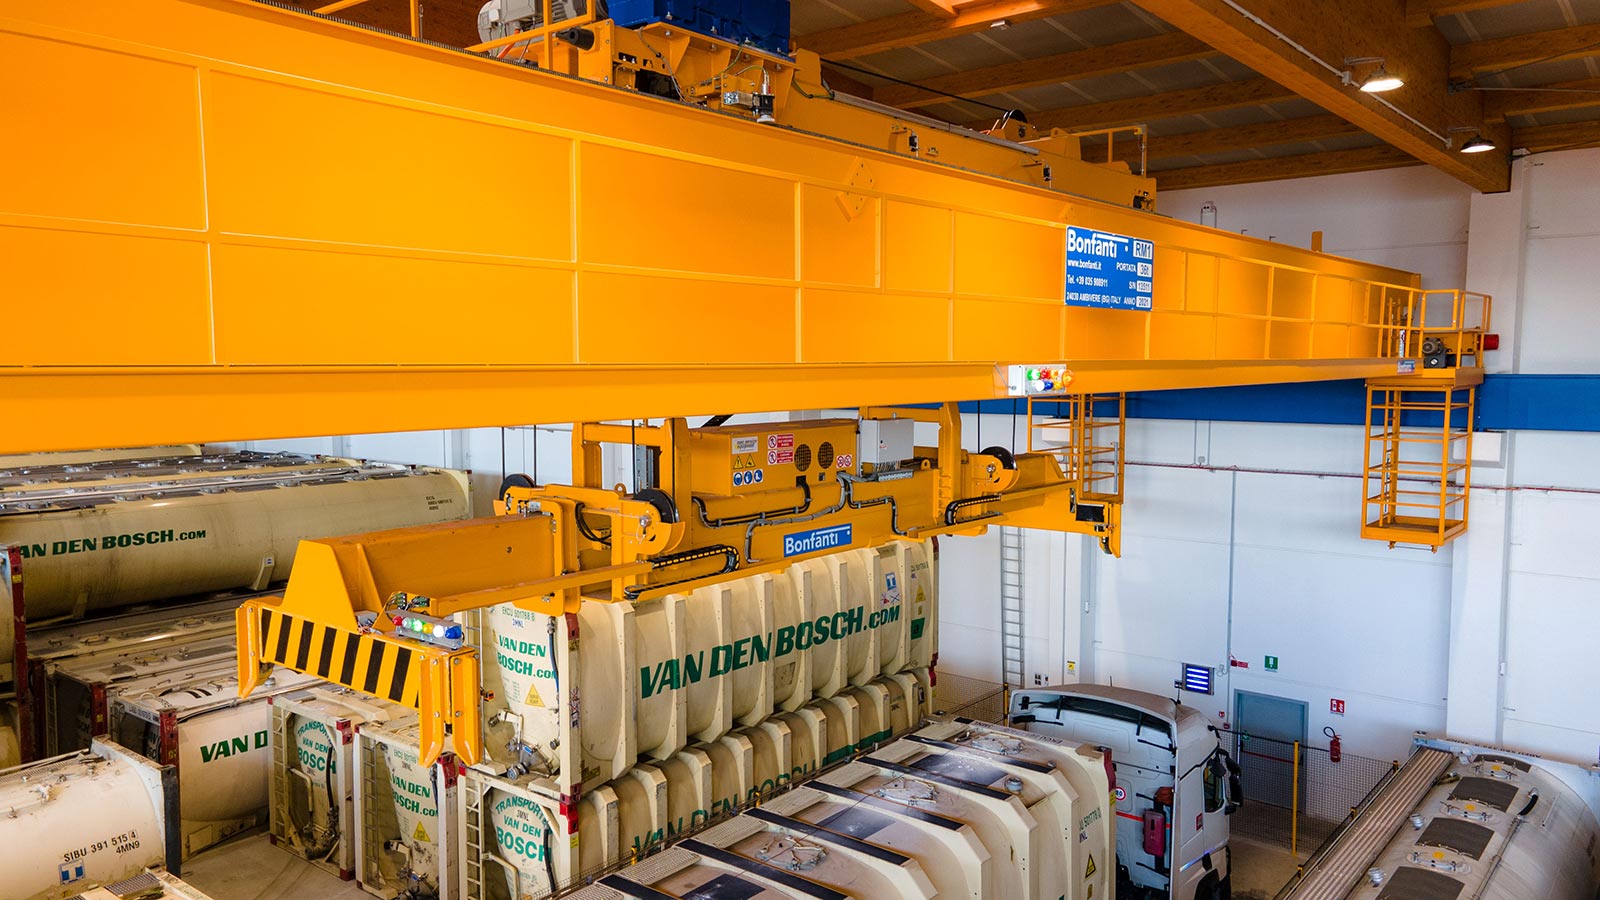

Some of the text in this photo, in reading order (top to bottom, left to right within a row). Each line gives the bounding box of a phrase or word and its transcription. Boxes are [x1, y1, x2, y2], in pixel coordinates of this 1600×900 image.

[1067, 229, 1117, 258] Bonfanti
[1135, 242, 1151, 258] RM1
[20, 543, 47, 559] AN
[52, 537, 97, 555] DEN
[785, 532, 838, 555] Bonfanti
[499, 635, 547, 658] VAN DEN
[641, 605, 900, 699] VAN DEN BOSCH.COM
[200, 735, 248, 763] VAN
[303, 737, 329, 753] VAN DEN
[391, 774, 431, 798] VAN DEN
[504, 815, 542, 838] VAN DEN
[64, 847, 87, 862] SIBU
[91, 840, 108, 853] 391
[112, 833, 128, 846] 515
[116, 840, 140, 855] 4MN9
